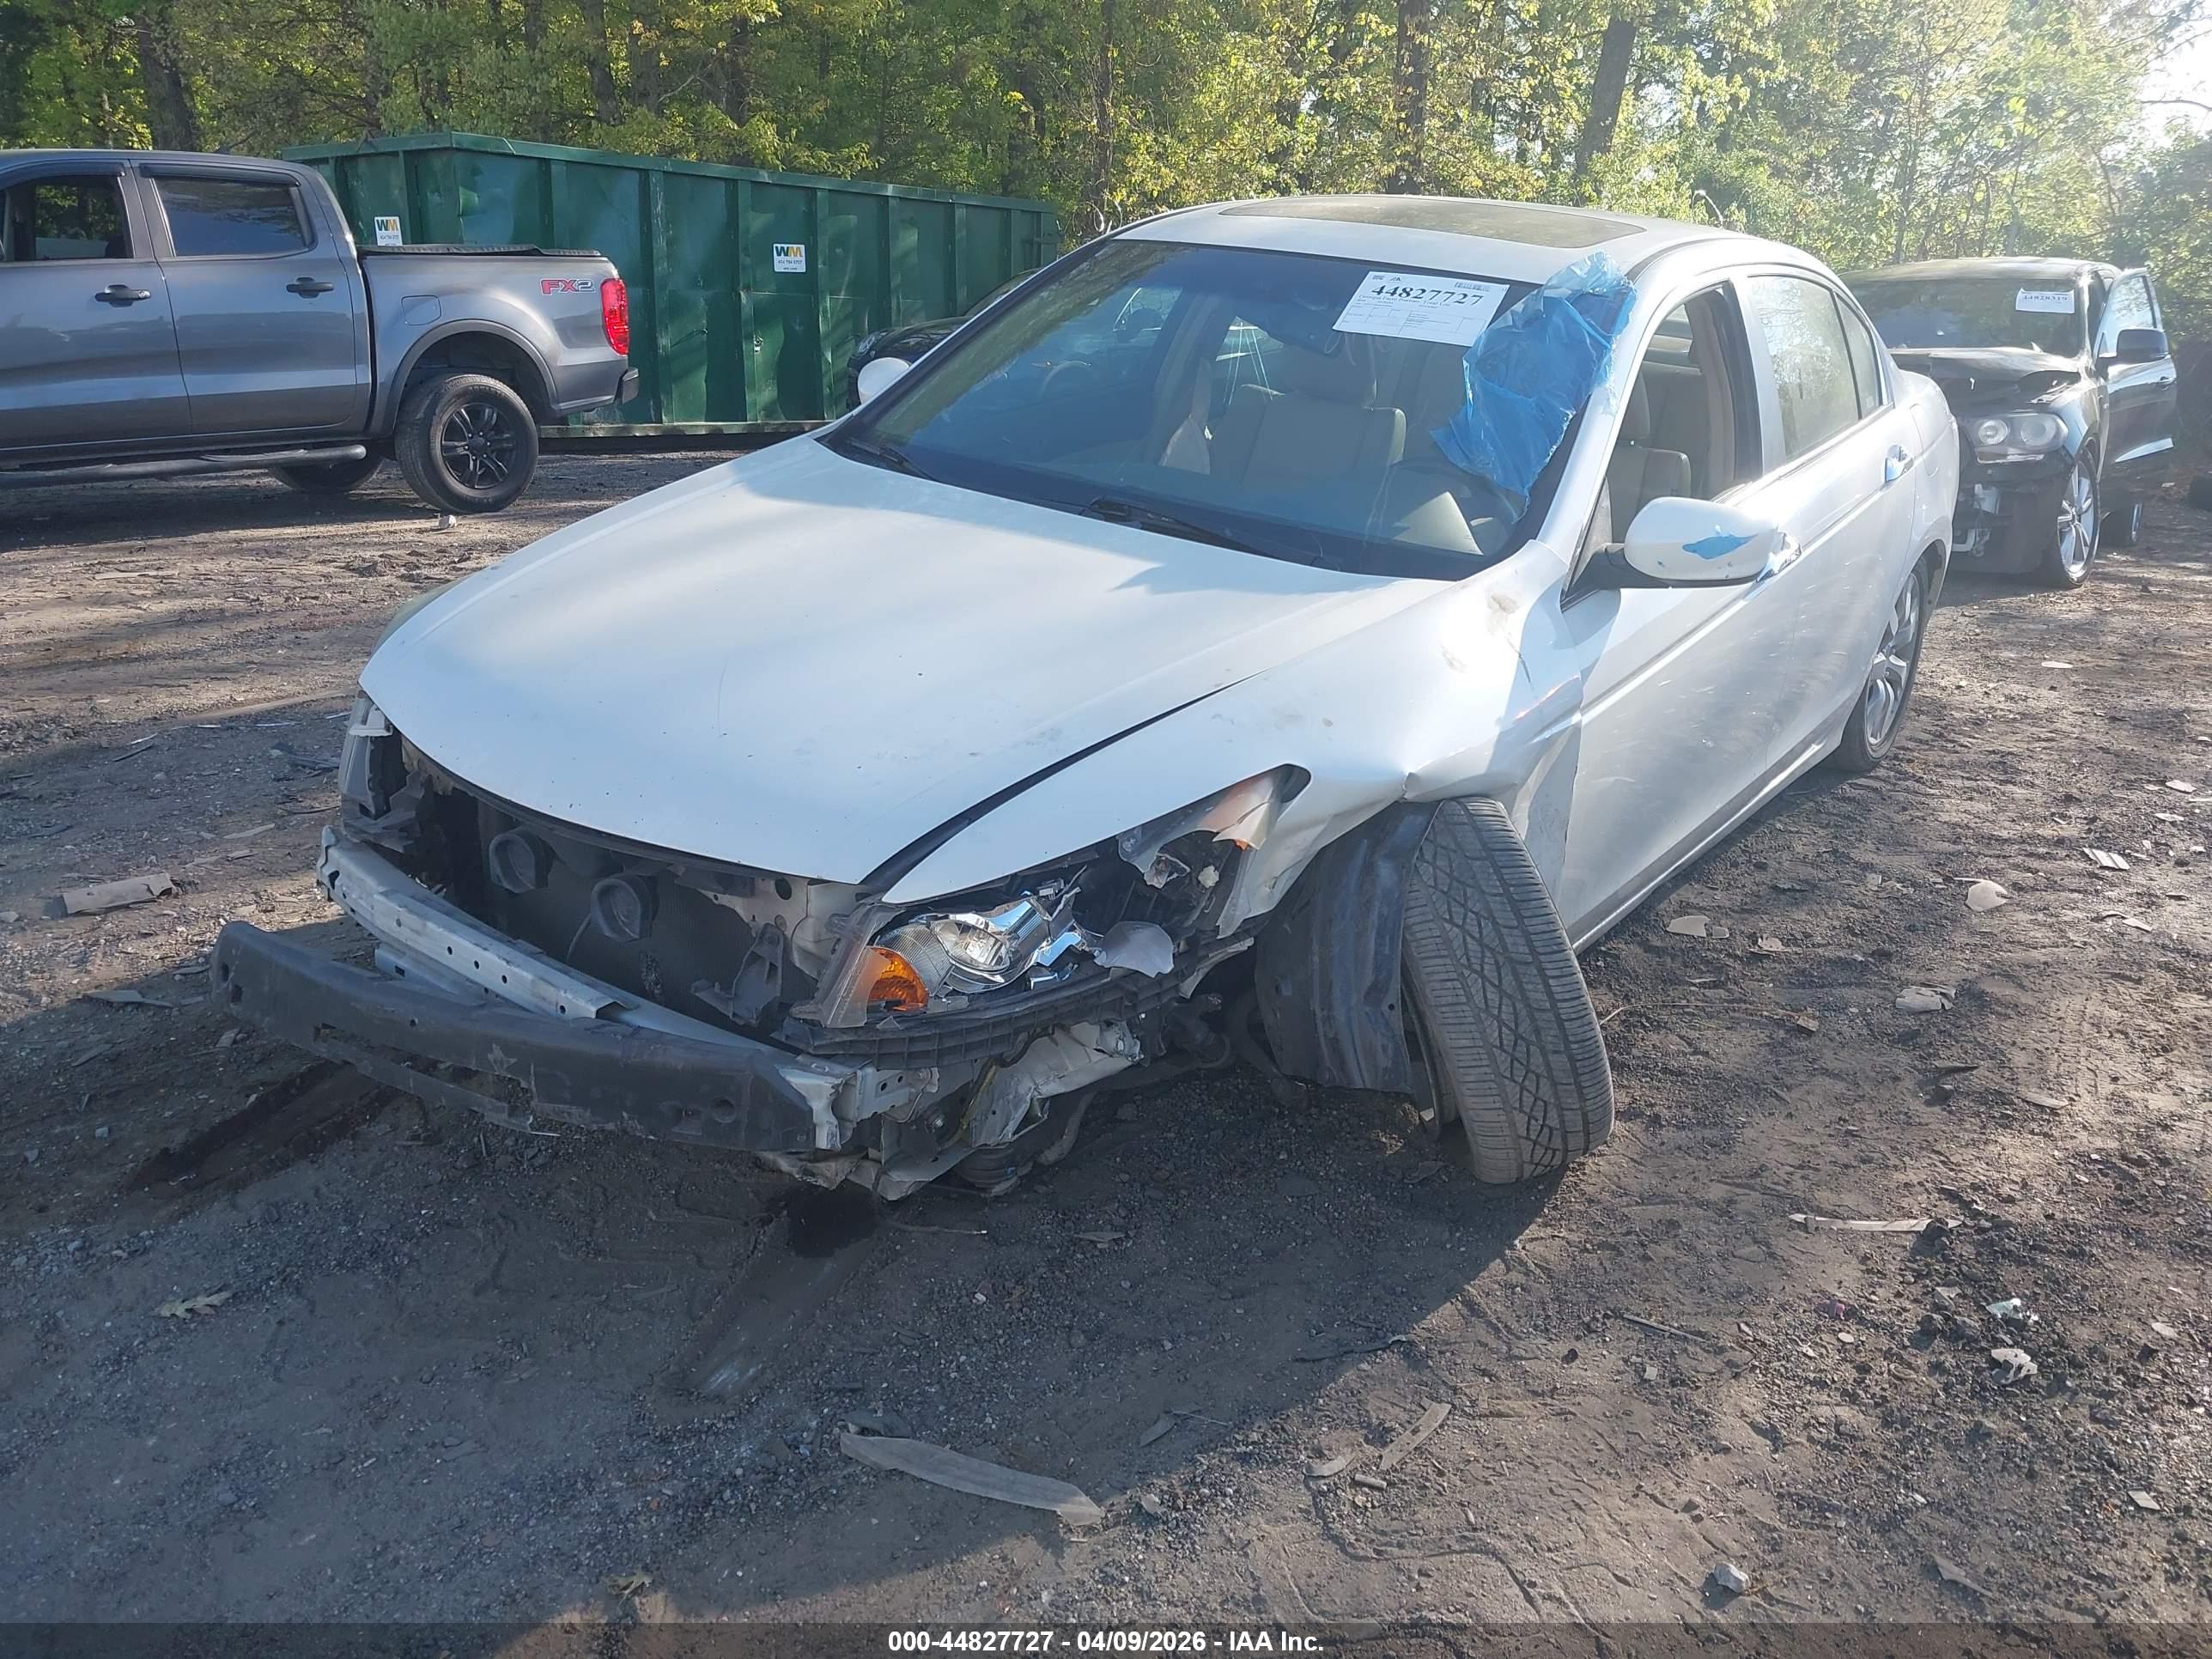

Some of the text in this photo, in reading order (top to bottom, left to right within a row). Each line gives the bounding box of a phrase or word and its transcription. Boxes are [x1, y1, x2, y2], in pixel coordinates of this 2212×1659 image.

[376, 219, 398, 231] WM
[775, 246, 803, 257] WM
[540, 279, 595, 295] FX2
[1371, 285, 1484, 306] 44827727
